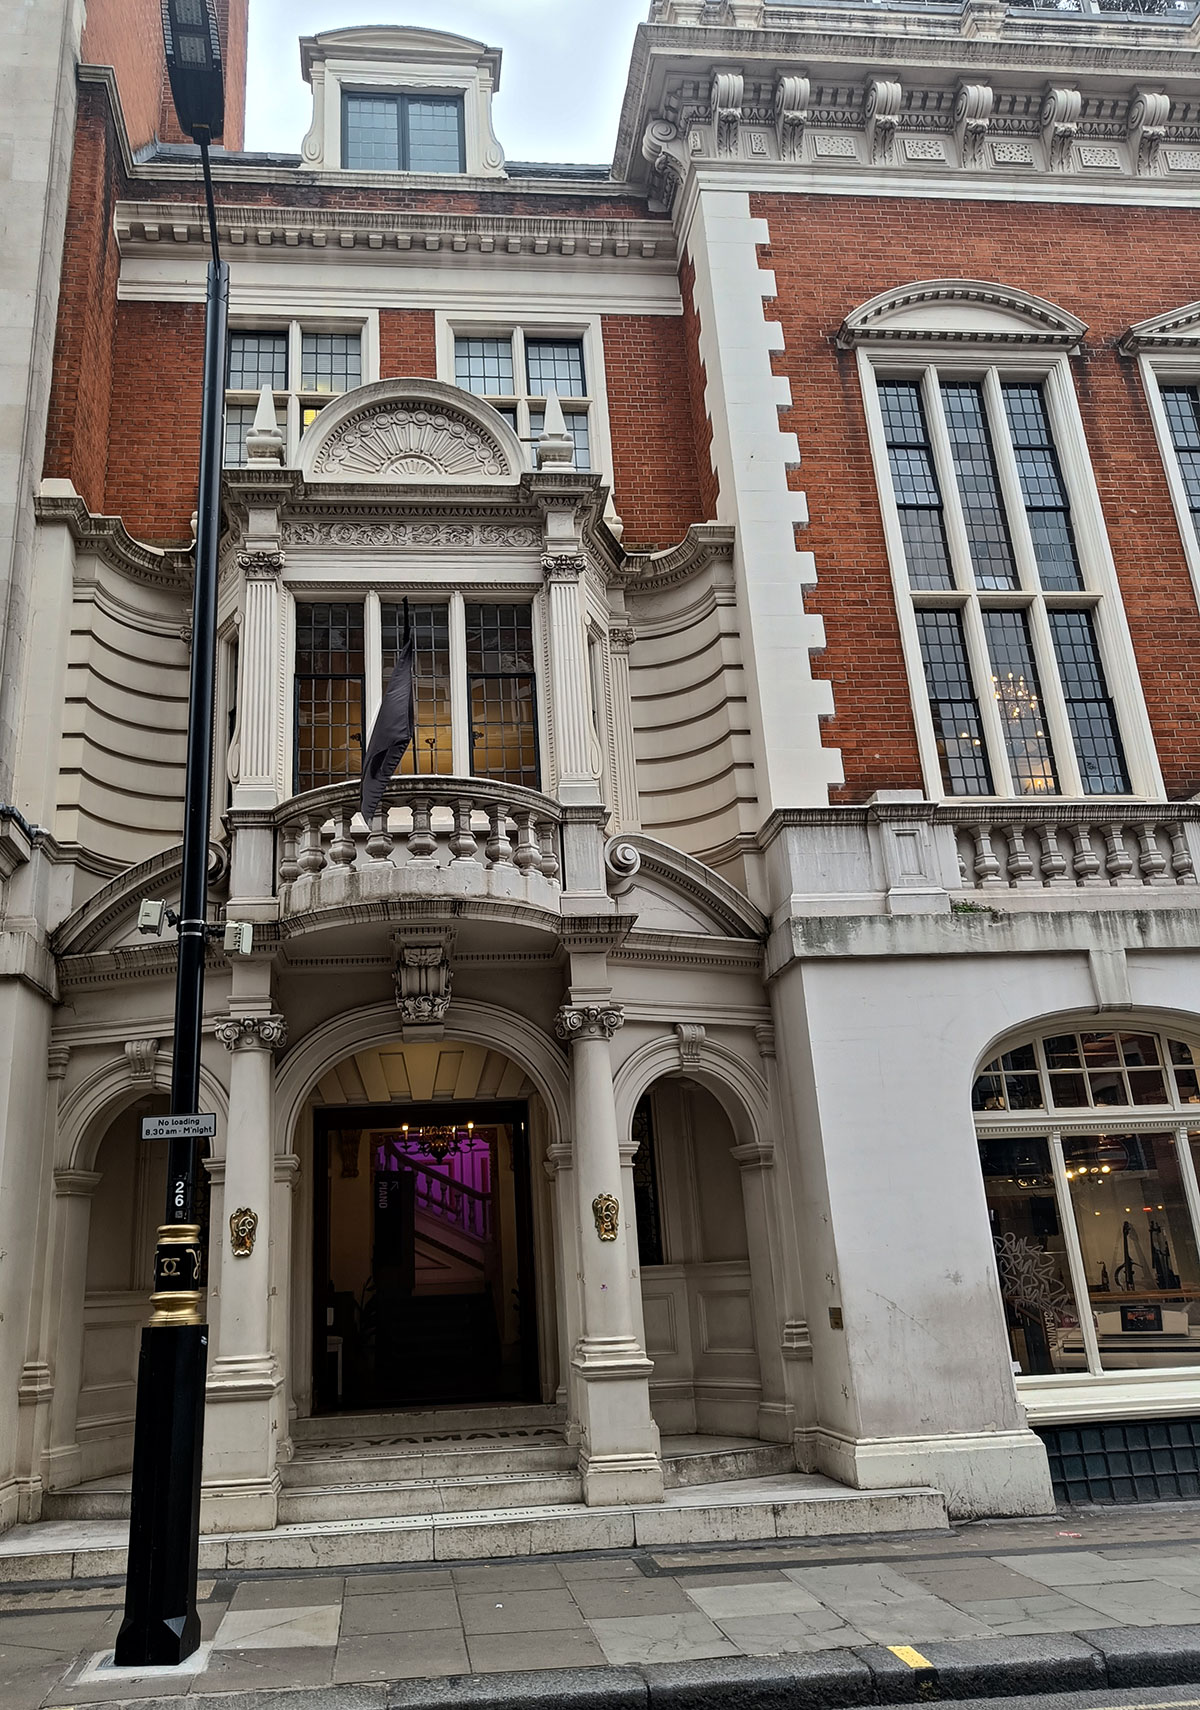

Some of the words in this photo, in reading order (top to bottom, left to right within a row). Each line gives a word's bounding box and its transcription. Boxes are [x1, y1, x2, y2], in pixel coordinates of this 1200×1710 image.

[145, 1127, 164, 1136] 8.30
[183, 1126, 212, 1135] M'night
[157, 1119, 170, 1127] No
[171, 1117, 200, 1126] loading
[174, 1181, 185, 1207] 26
[378, 1181, 388, 1209] PIANO
[362, 1428, 564, 1446] YAMAHA
[320, 1481, 402, 1490] YAMAHA
[485, 1470, 572, 1479] LONDON
[317, 1521, 375, 1530] World's
[423, 1513, 489, 1522] Inspiring
[493, 1509, 536, 1517] Music
